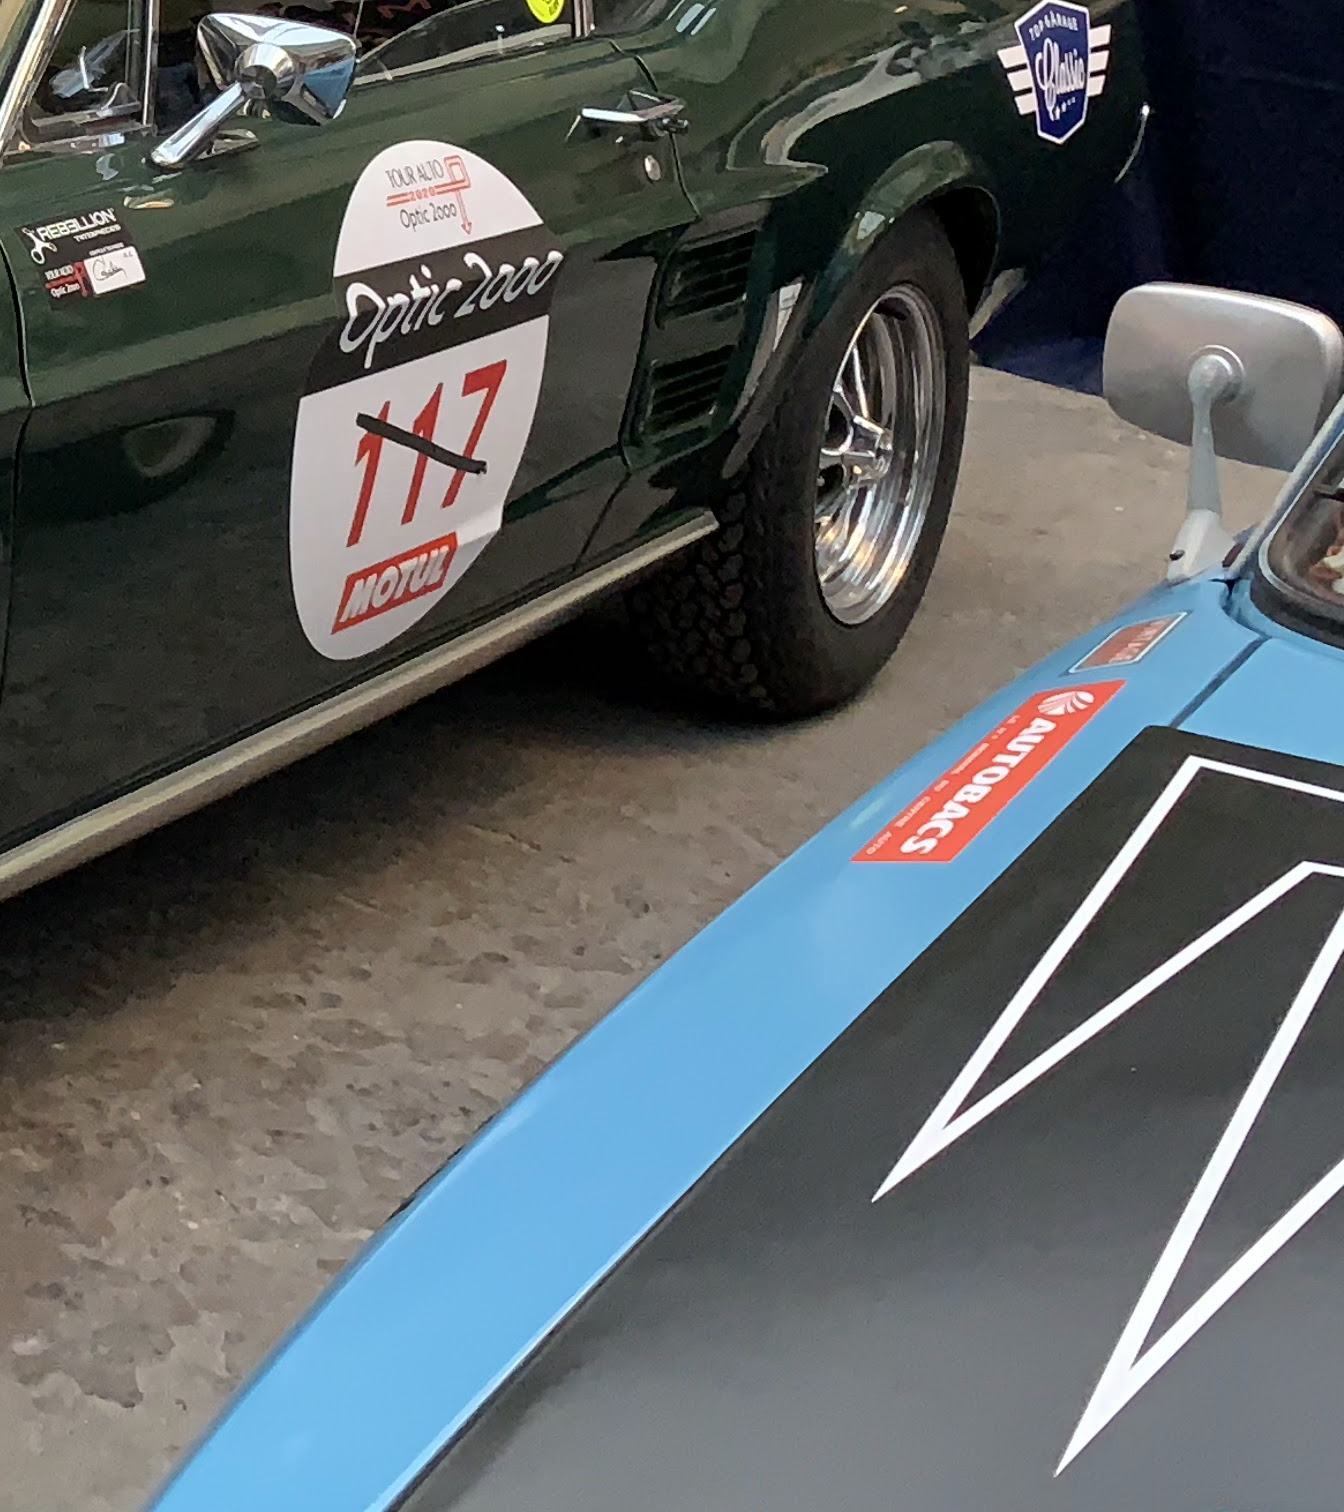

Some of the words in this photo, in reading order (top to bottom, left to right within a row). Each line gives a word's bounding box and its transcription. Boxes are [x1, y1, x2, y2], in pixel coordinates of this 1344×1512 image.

[1028, 19, 1045, 41] TOP
[1044, 10, 1080, 32] GARAGE
[1035, 38, 1086, 122] Classic
[36, 207, 117, 241] REBELLION
[400, 205, 430, 232] Optic
[430, 202, 458, 224] 2000
[339, 264, 462, 369] Optic
[454, 250, 564, 318] 2000
[346, 359, 507, 548] 117
[338, 545, 450, 623] MOTUL
[899, 716, 1057, 856] AUTOBACS
